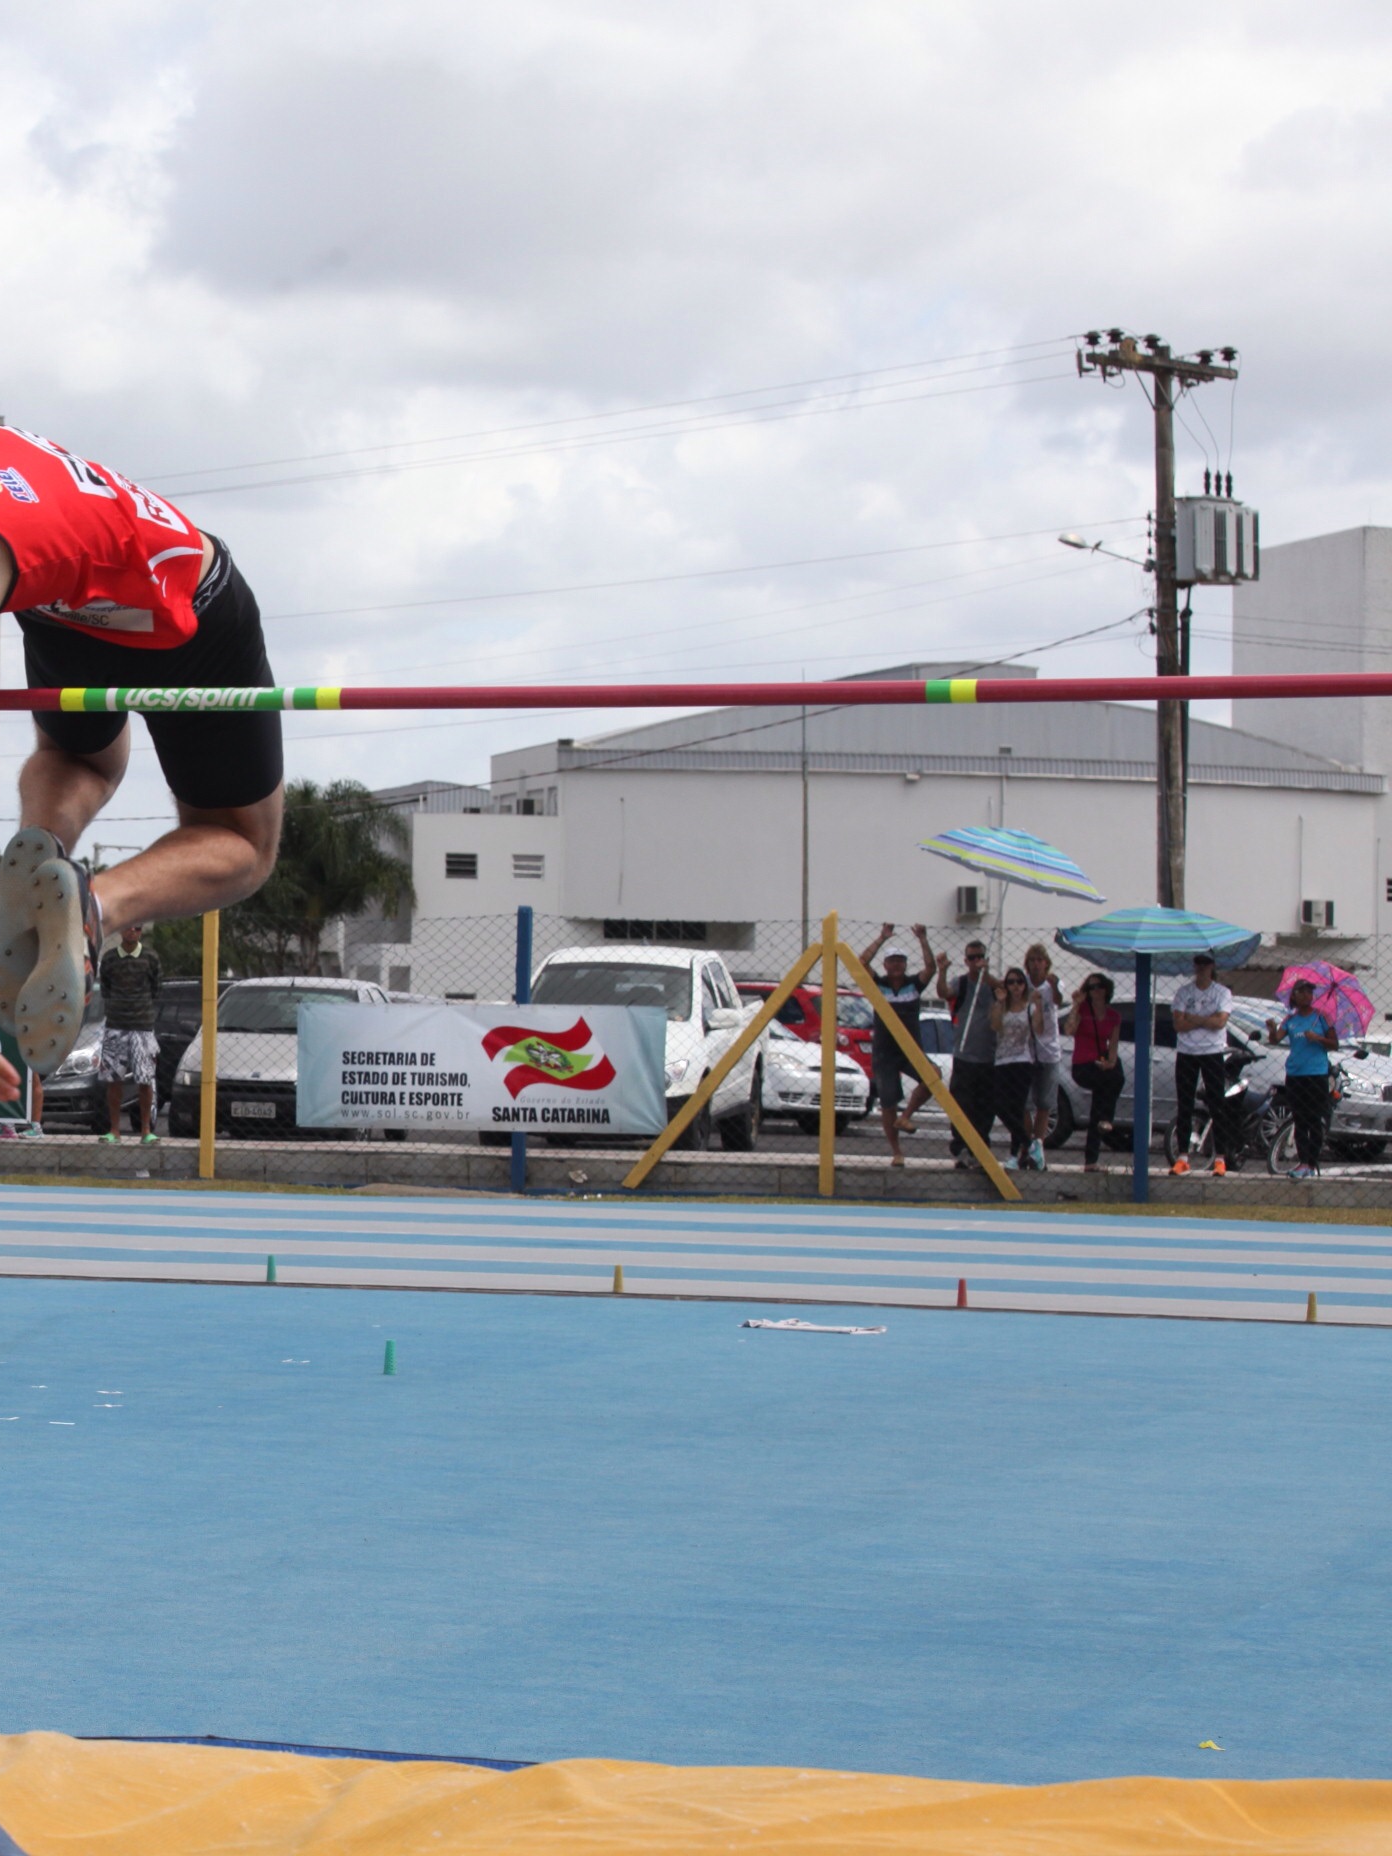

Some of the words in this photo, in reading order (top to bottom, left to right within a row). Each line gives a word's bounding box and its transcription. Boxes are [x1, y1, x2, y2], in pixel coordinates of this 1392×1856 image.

[342, 1051, 417, 1066] SECRETARIA
[420, 1053, 436, 1066] DE
[341, 1071, 388, 1086] ESTADO
[392, 1072, 407, 1086] DE
[410, 1072, 471, 1088] TURISMO,
[341, 1091, 396, 1106] CULTURA
[399, 1092, 406, 1105] E
[409, 1092, 463, 1107] ESPORTE
[561, 1097, 571, 1105] do
[576, 1097, 606, 1105] Estado
[340, 1108, 470, 1120] www.sol.sc.gov.br
[492, 1107, 538, 1122] SANTA
[541, 1108, 611, 1124] CATARINA
